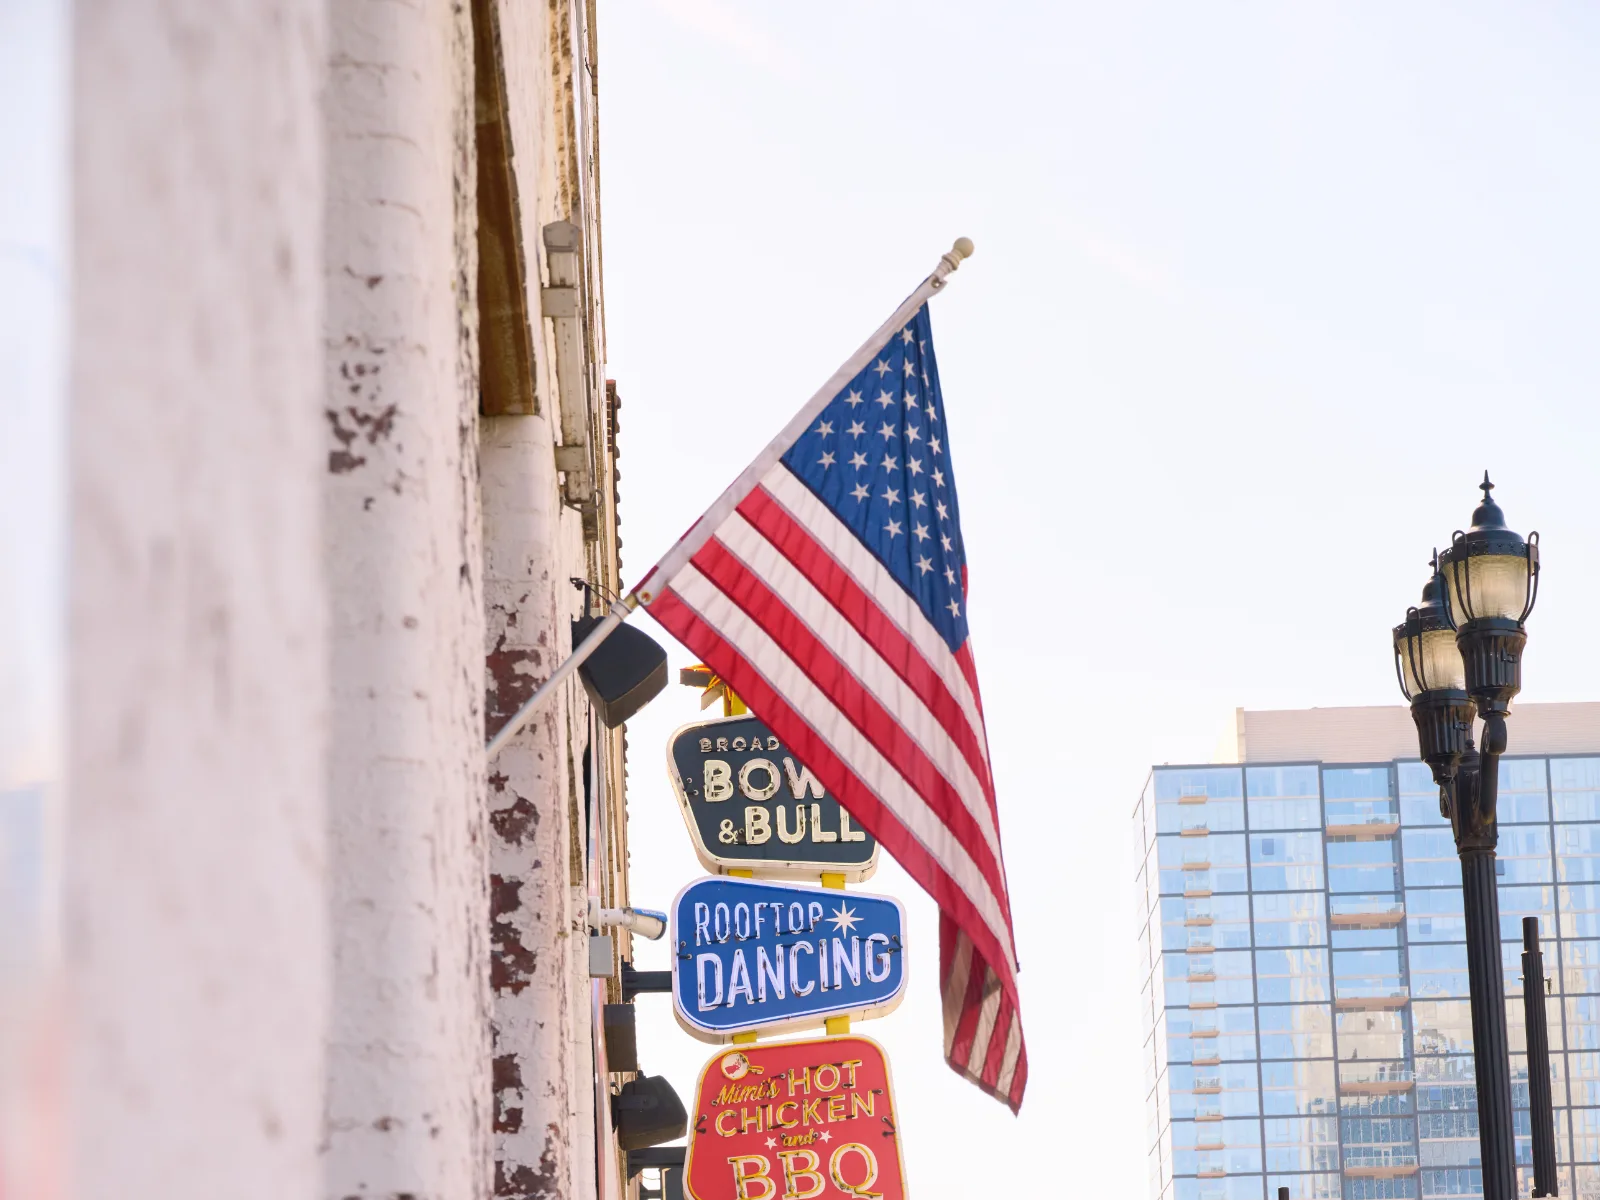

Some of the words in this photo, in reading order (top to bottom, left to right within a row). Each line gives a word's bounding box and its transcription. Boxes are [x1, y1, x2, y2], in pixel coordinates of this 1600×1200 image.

[744, 803, 867, 845] BULL
[694, 901, 824, 947] ROOFTOP
[696, 932, 892, 1012] DANCING
[715, 1078, 780, 1106] Mimi's
[788, 1059, 863, 1097] HOT
[714, 1089, 876, 1138] CHICKEN
[782, 1127, 817, 1148] and
